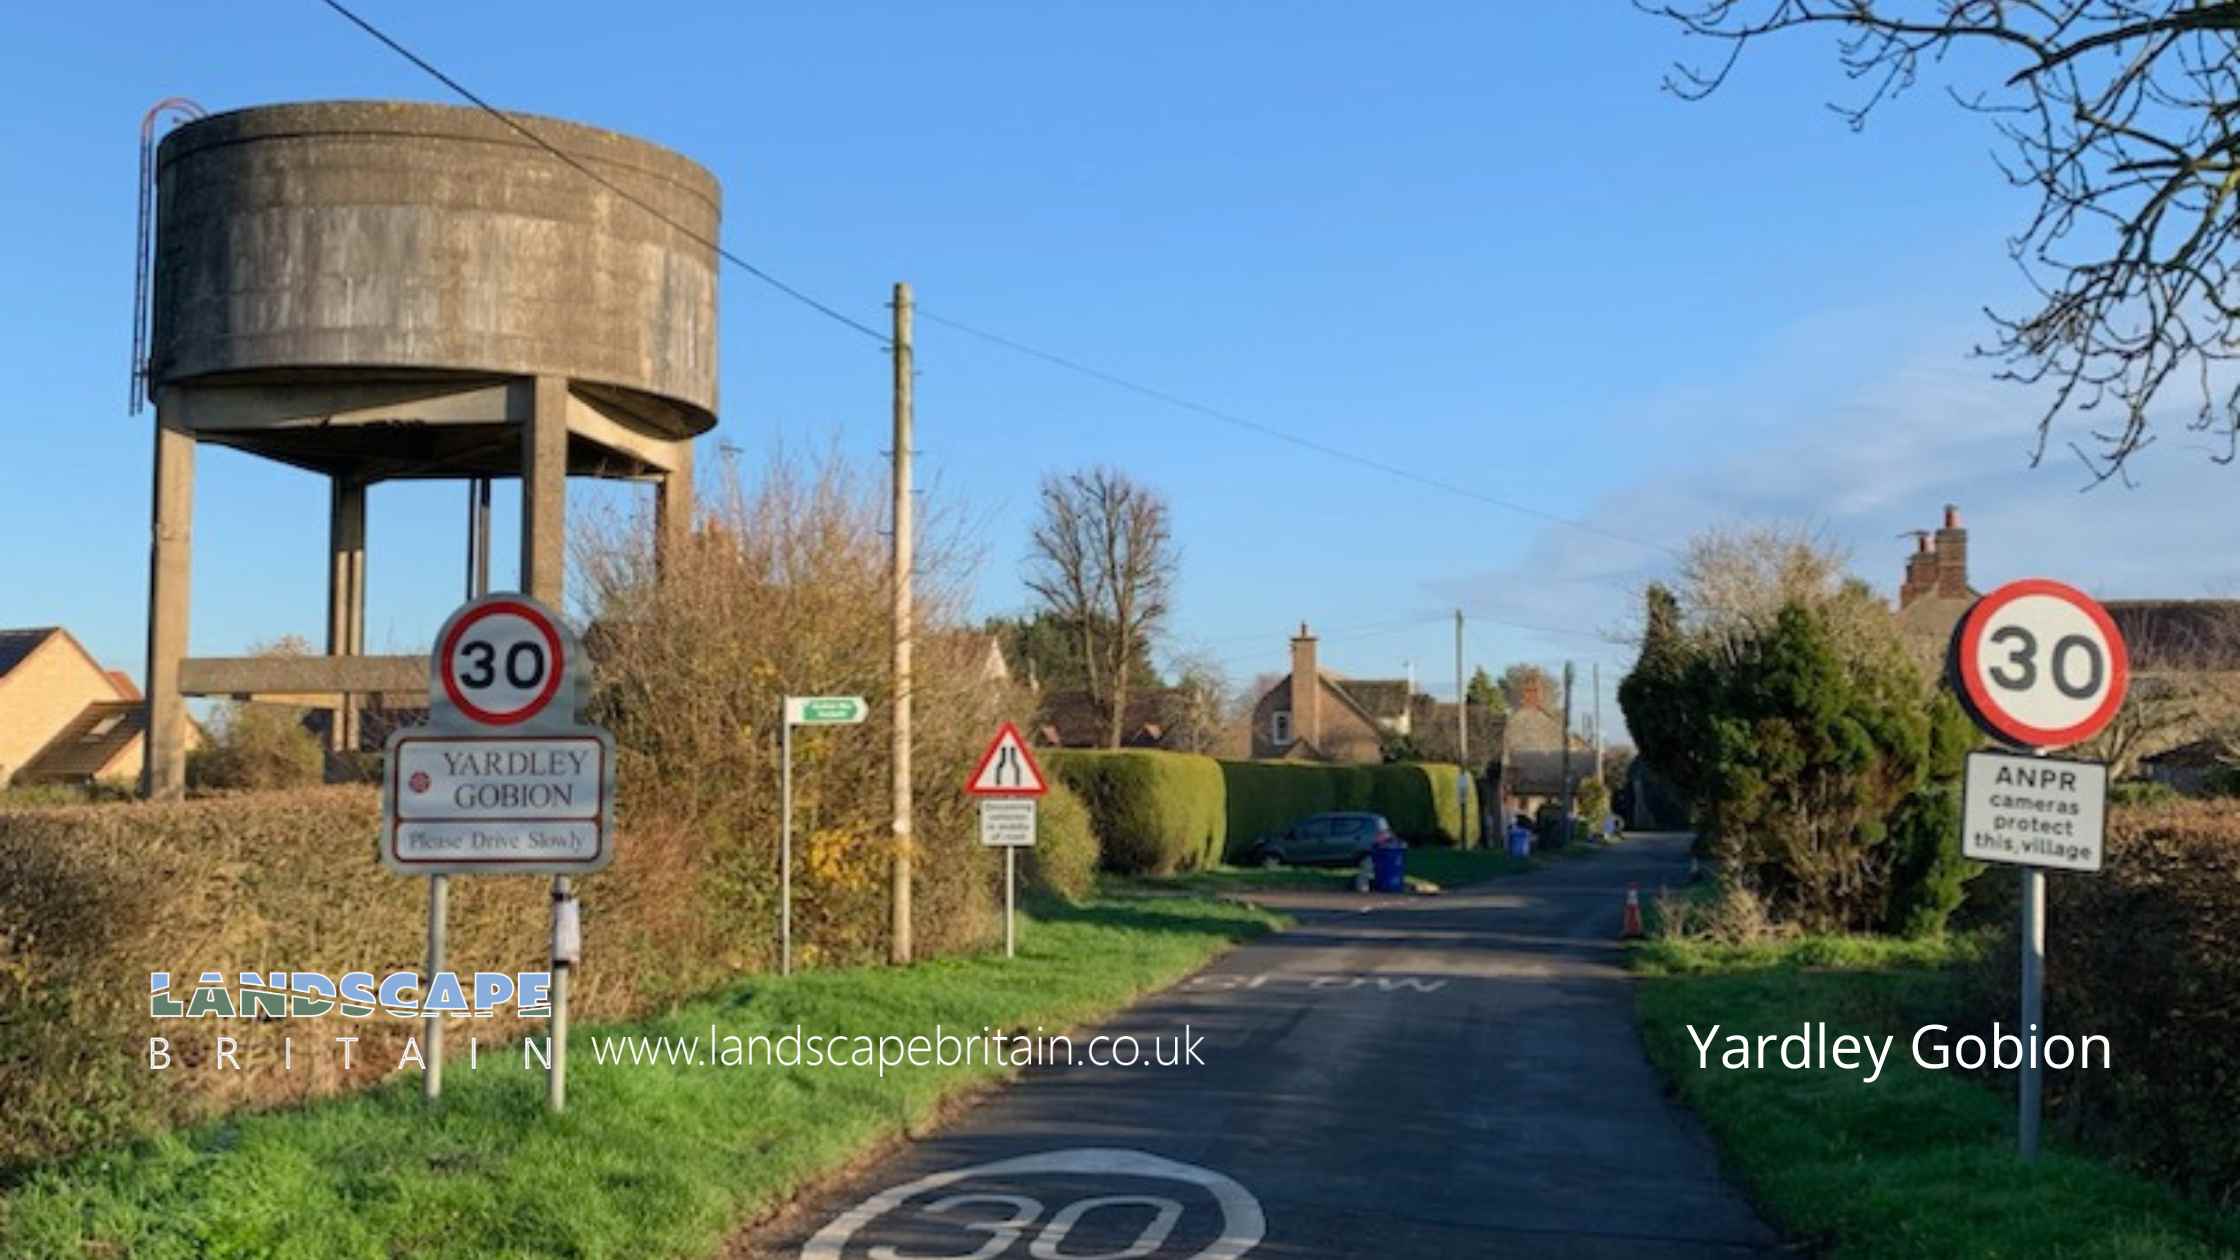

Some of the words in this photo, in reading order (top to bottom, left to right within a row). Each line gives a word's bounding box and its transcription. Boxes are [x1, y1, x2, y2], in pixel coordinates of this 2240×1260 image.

[461, 640, 545, 690] 30
[1989, 626, 2104, 700] 30
[443, 751, 588, 776] YARDLEY
[1995, 766, 2077, 791] ANPR
[454, 783, 573, 809] GOBION
[1989, 793, 2080, 815] cameras
[1993, 814, 2073, 837] protect
[408, 832, 462, 849] Please
[472, 832, 519, 849] Drive
[528, 830, 585, 853] Slowly
[2021, 835, 2092, 861] village
[868, 1194, 1184, 1260] 30
